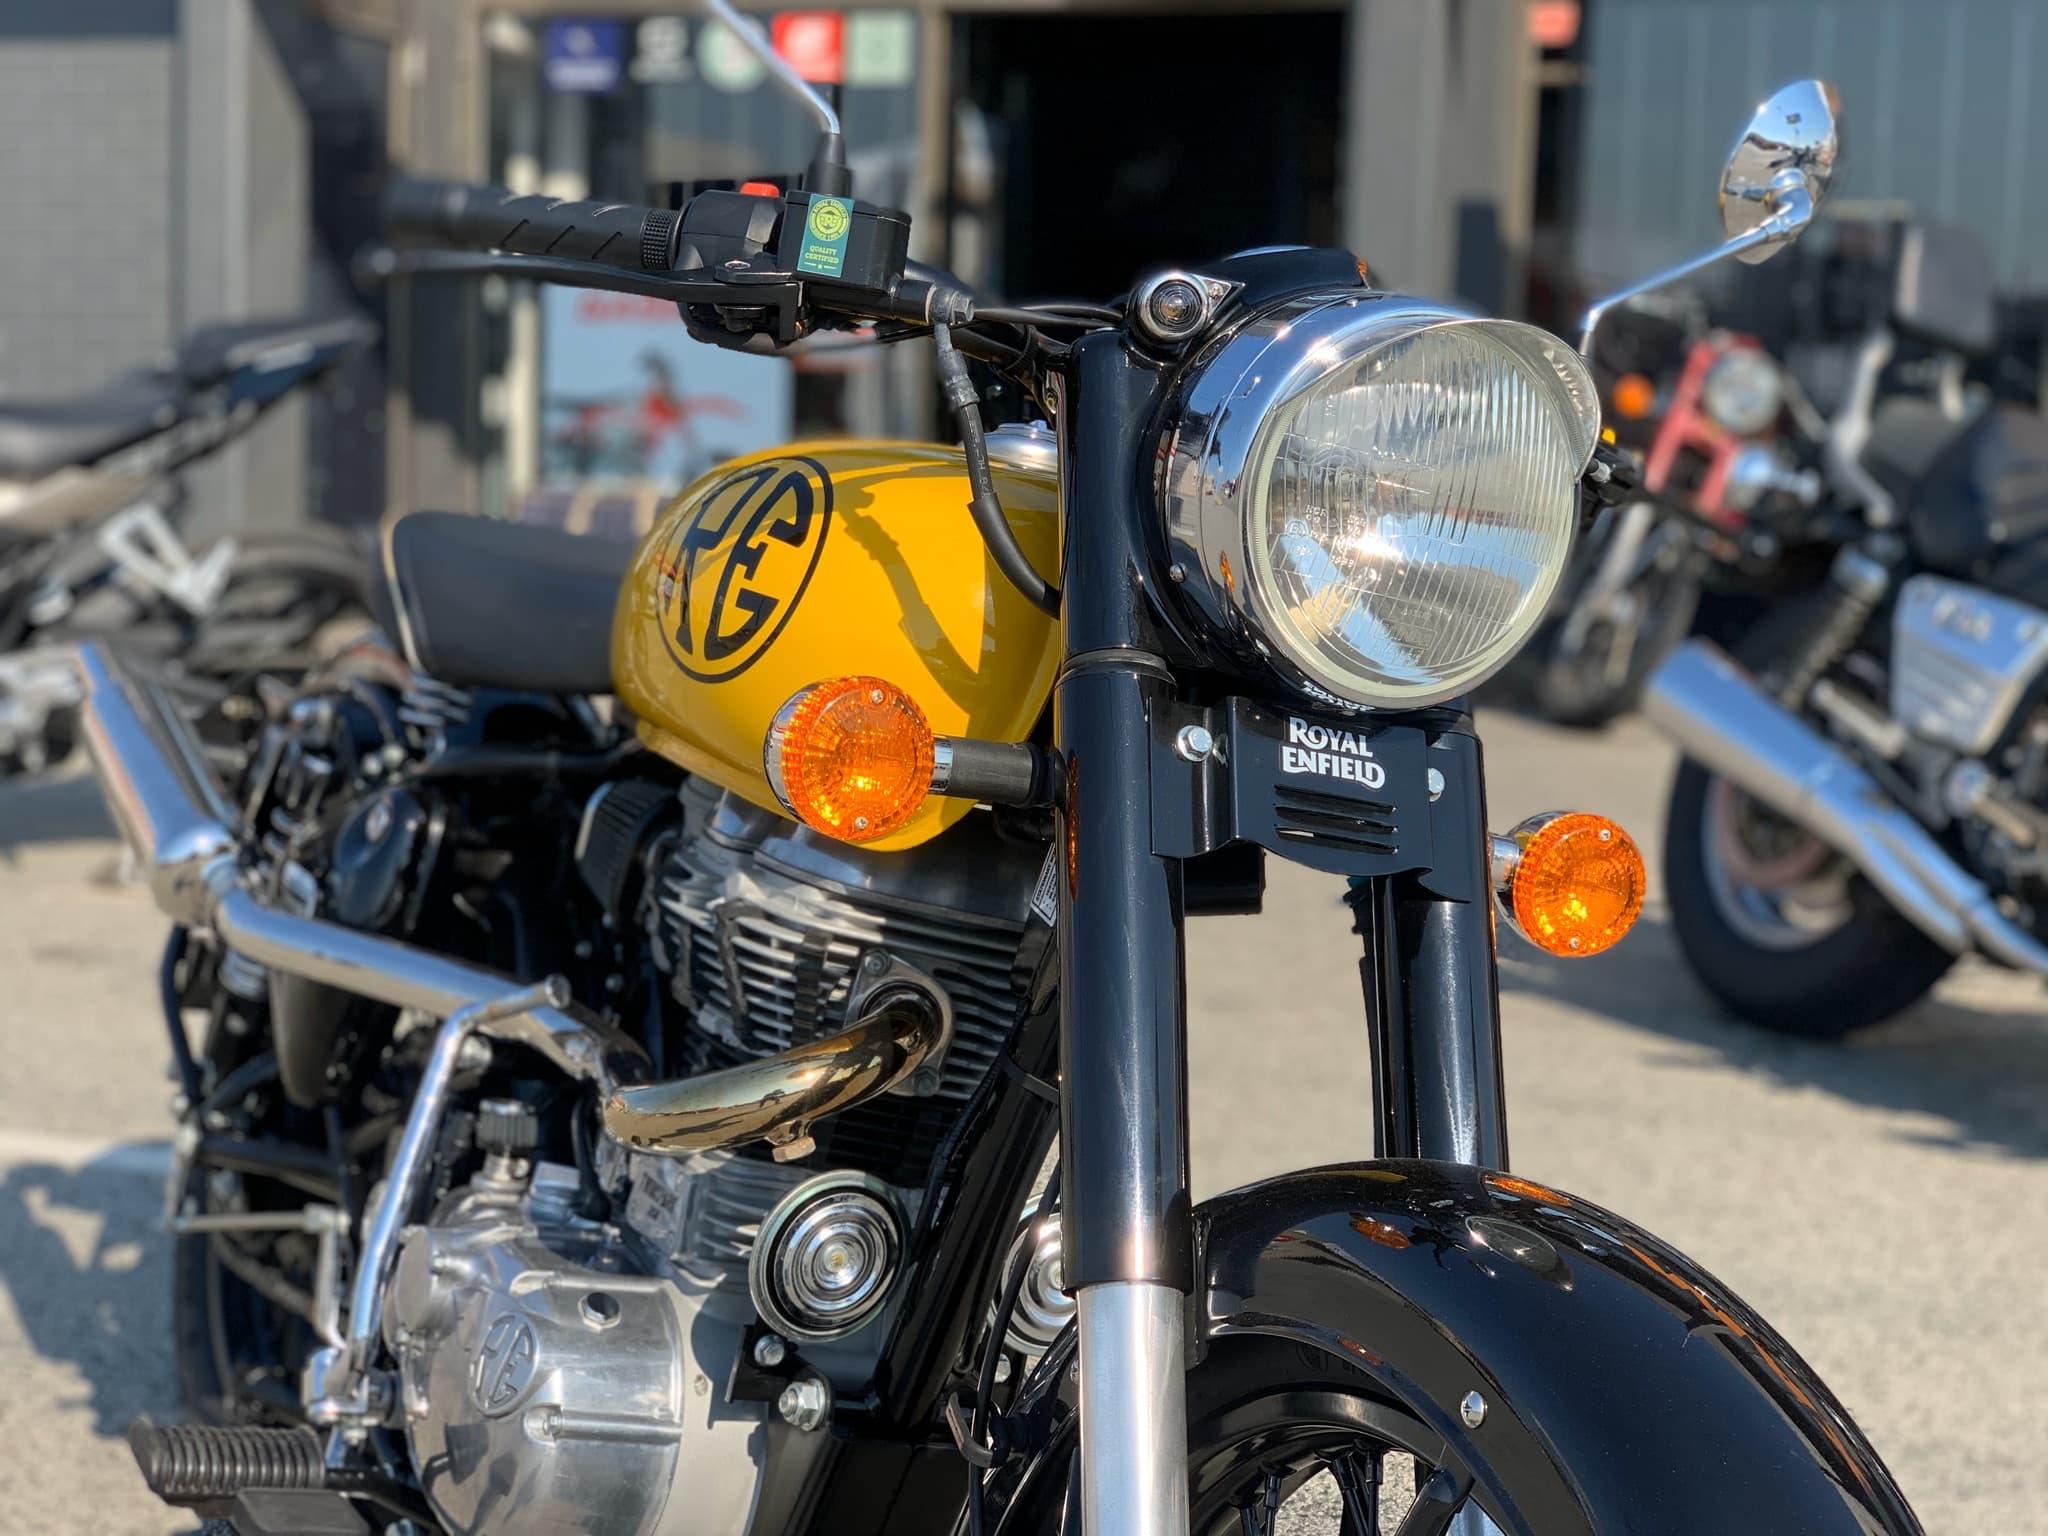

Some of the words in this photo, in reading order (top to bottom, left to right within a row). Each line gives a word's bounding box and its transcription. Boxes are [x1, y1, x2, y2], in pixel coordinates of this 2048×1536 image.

[804, 252, 839, 264] CERTIFIED
[809, 245, 837, 255] QUALITY
[1289, 716, 1373, 757] ROYAL
[1282, 746, 1385, 789] ENFIELD
